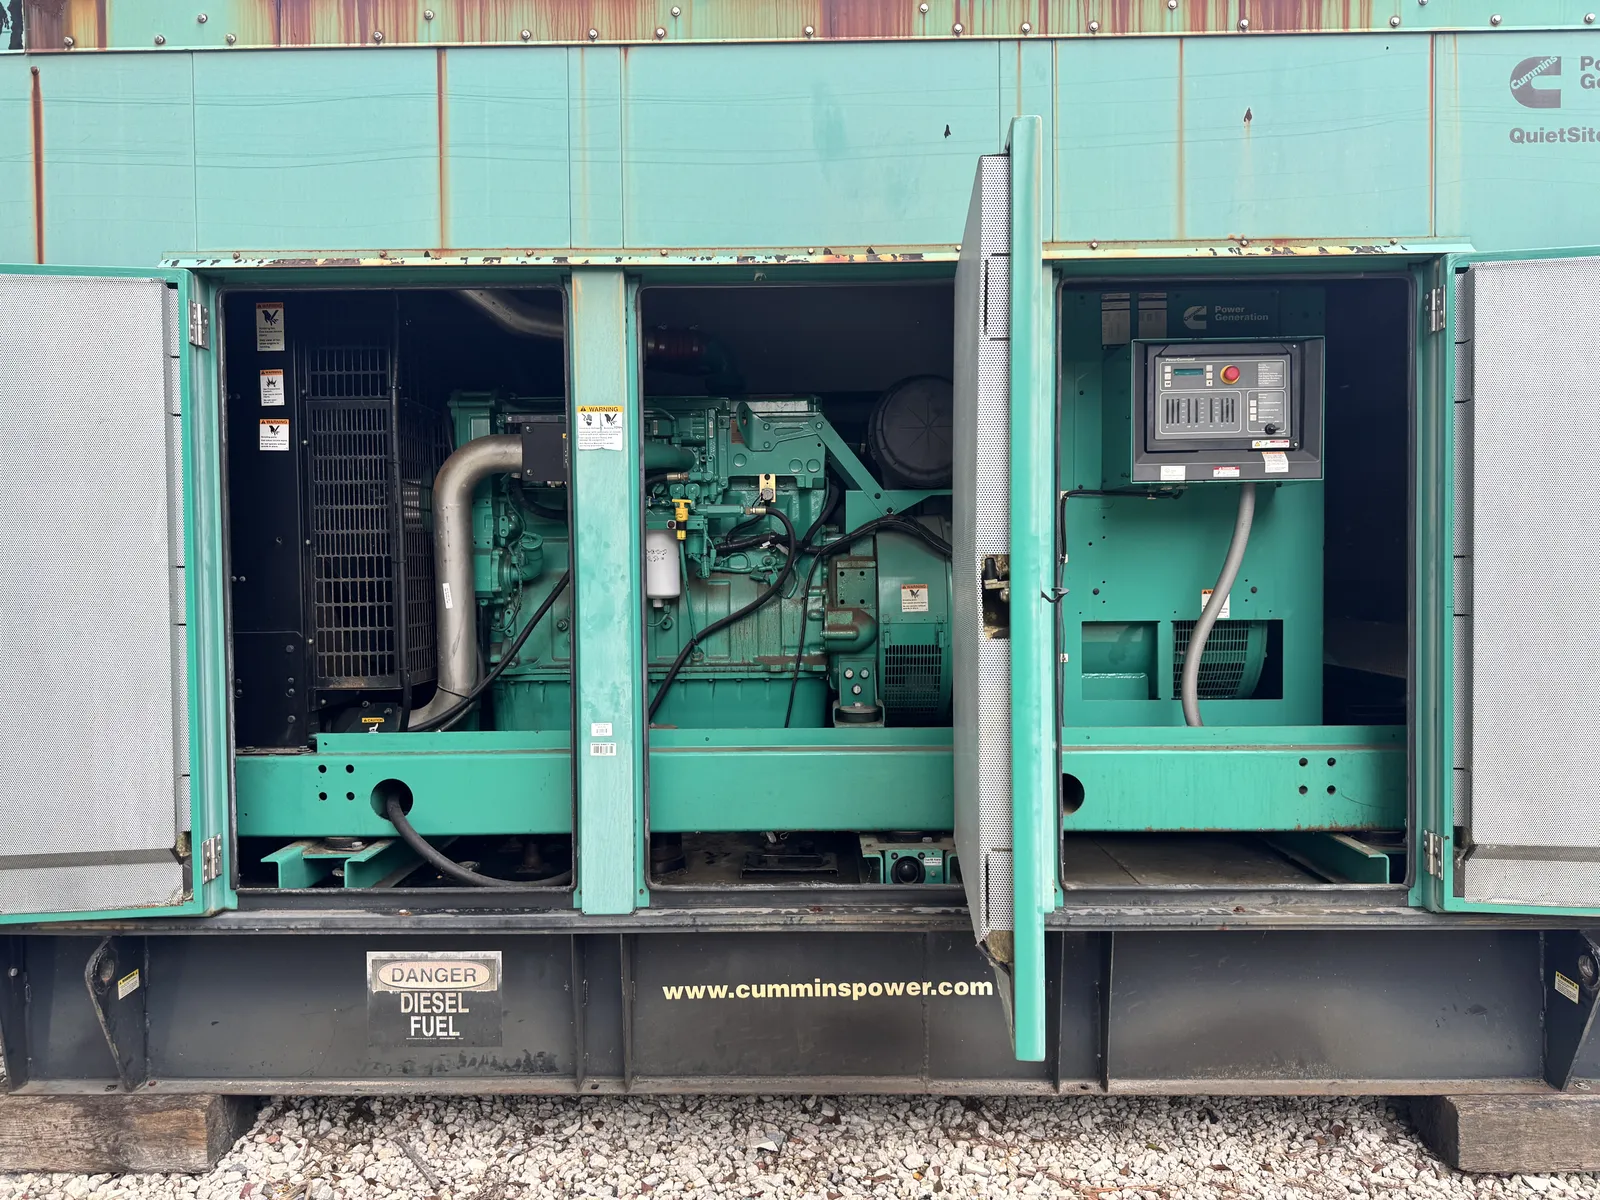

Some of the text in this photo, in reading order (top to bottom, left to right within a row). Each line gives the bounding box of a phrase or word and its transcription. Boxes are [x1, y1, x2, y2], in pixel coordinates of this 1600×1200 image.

[1510, 55, 1558, 90] Cummins
[1580, 73, 1600, 89] G
[1214, 305, 1246, 314] Power
[1214, 313, 1269, 322] Generation
[391, 967, 477, 983] DANGER
[662, 978, 994, 1001] www.cumminspower.com
[400, 992, 470, 1014] DIESEL
[410, 1015, 461, 1037] FUEL
